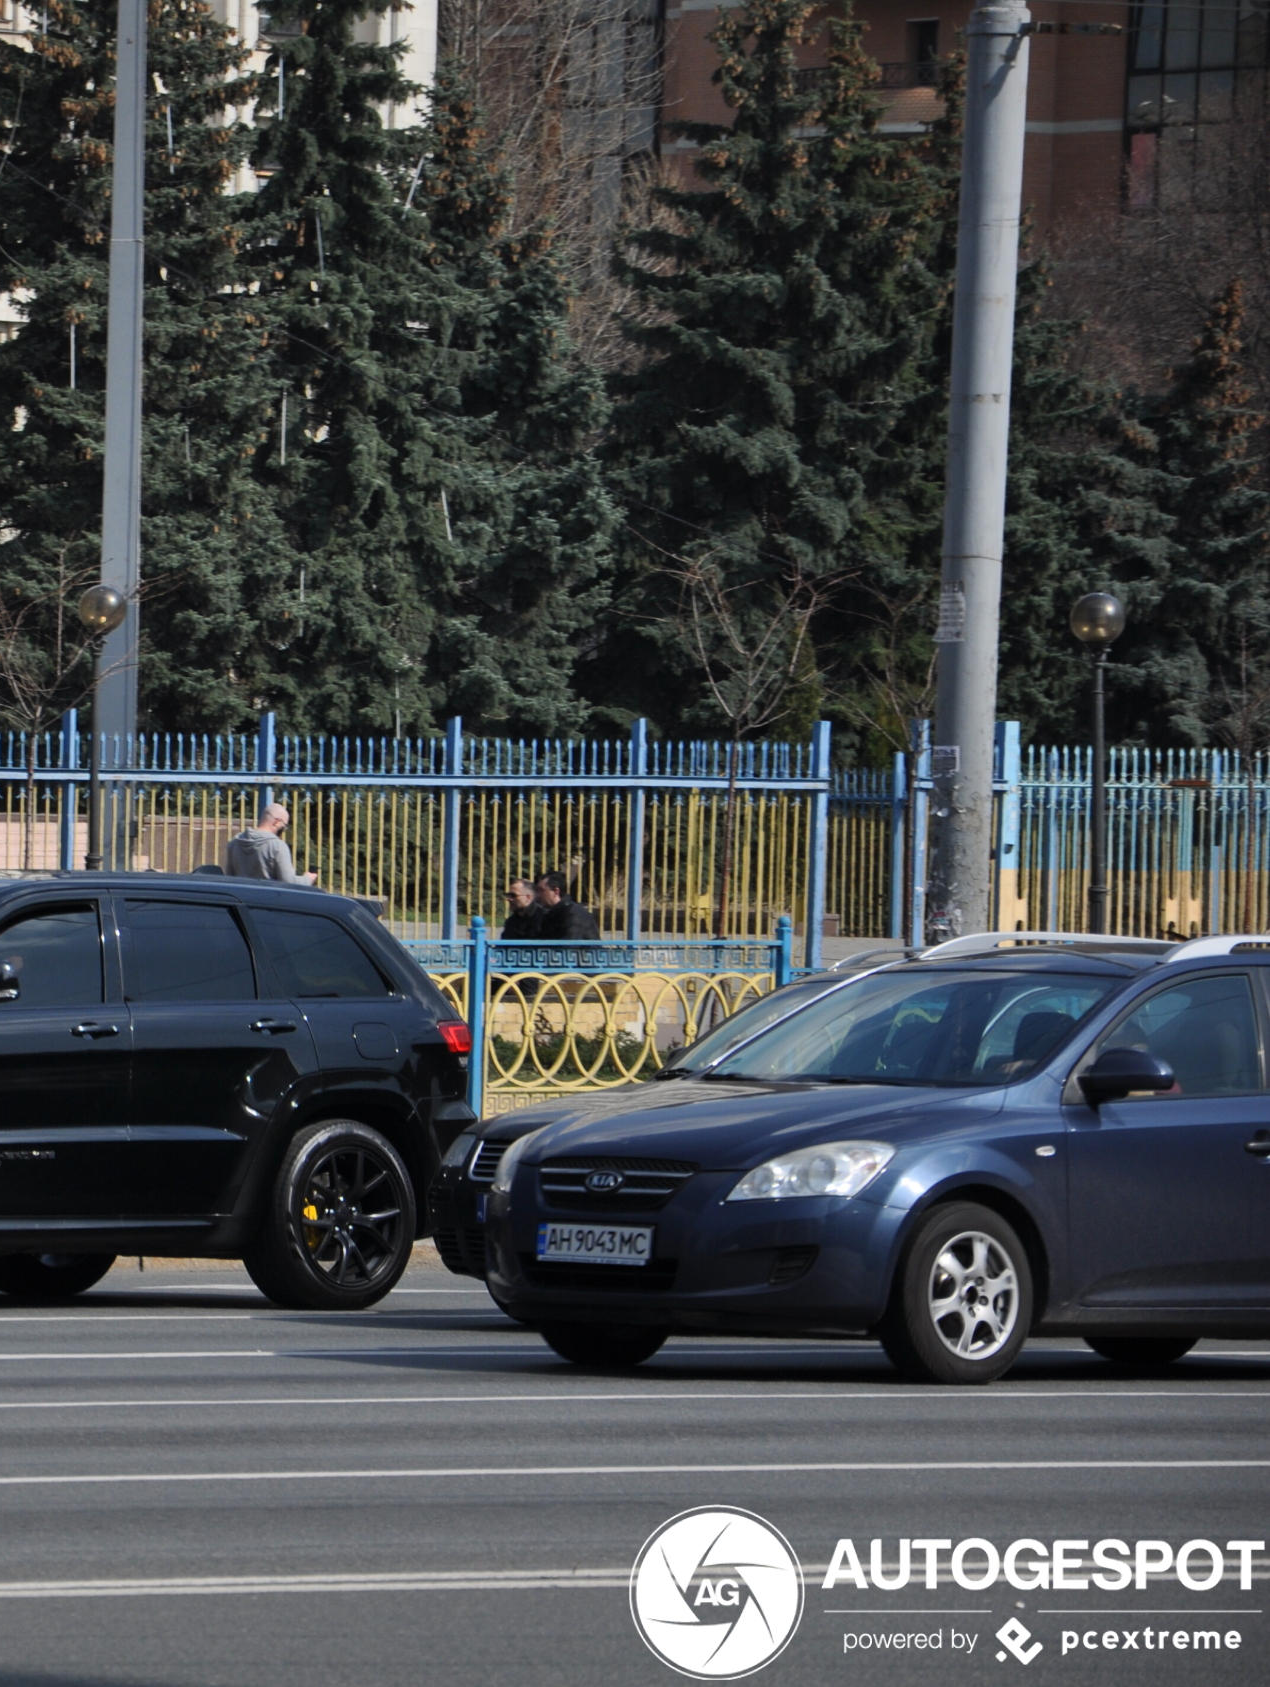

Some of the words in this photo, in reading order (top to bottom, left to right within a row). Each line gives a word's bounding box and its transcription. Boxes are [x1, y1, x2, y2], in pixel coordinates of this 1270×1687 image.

[591, 1175, 615, 1187] KIA
[547, 1228, 572, 1251] AH
[575, 1229, 617, 1253] 9043
[618, 1231, 647, 1255] MC
